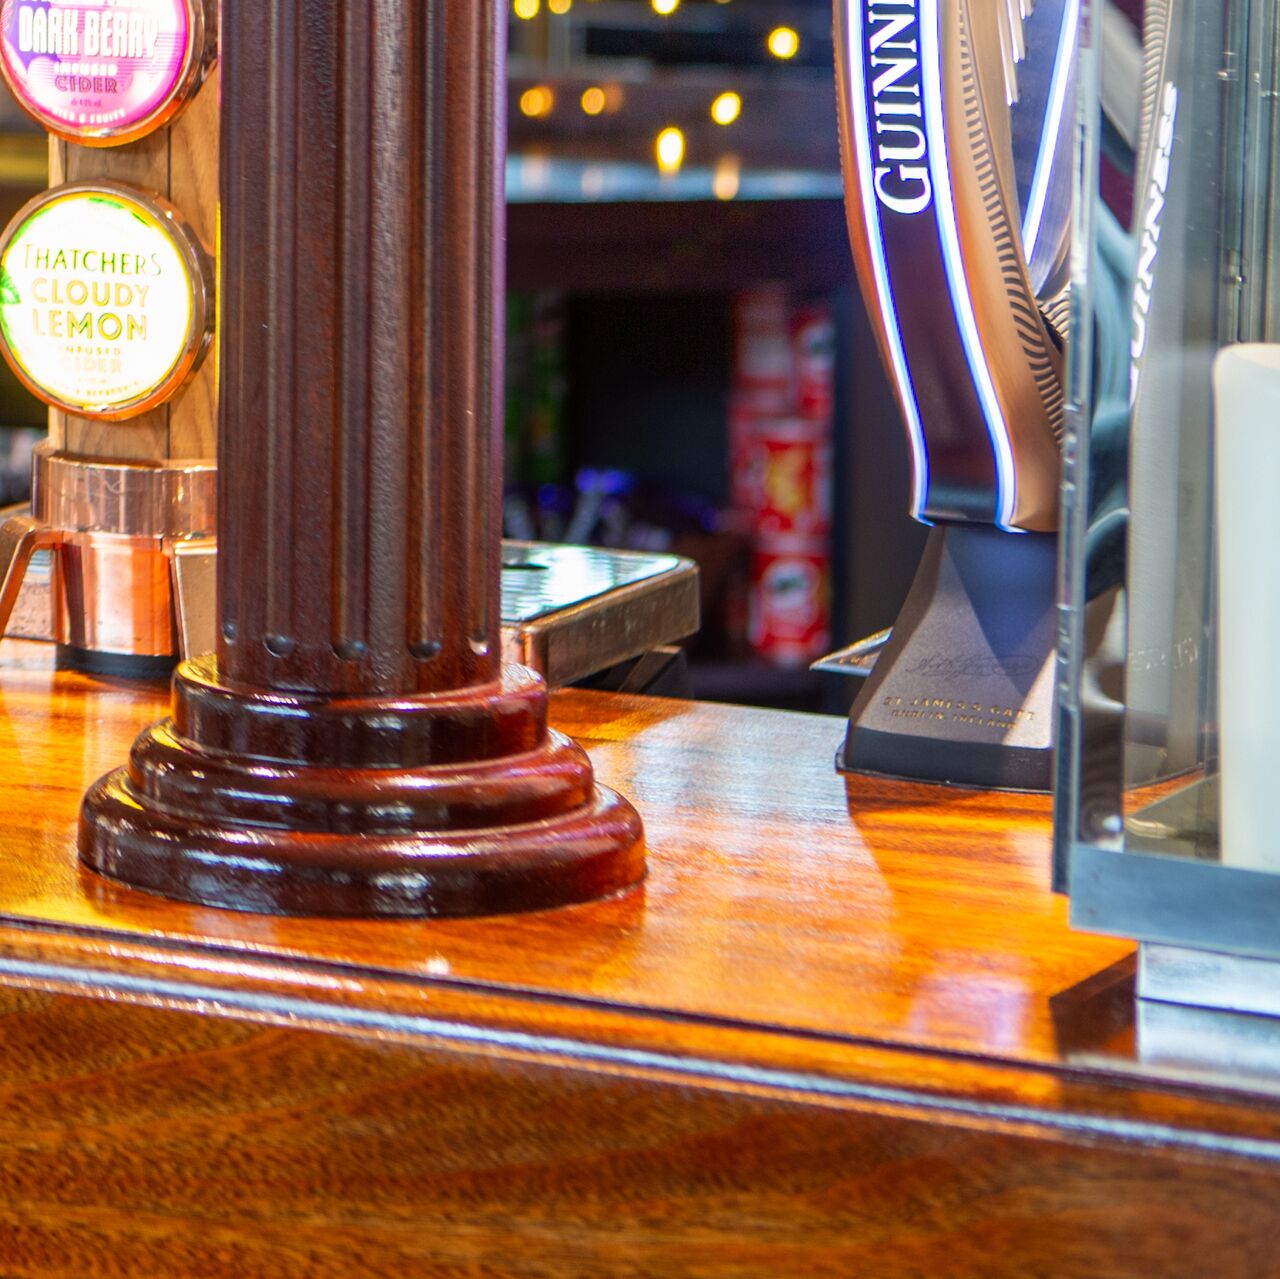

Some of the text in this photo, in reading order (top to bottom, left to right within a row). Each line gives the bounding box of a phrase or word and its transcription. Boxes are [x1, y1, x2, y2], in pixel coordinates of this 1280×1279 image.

[18, 5, 160, 59] DARK BERRY
[55, 75, 118, 94] CIDER
[23, 243, 163, 277] THATCHERS
[31, 277, 151, 308] CLOUDY
[32, 308, 148, 341] LEMON
